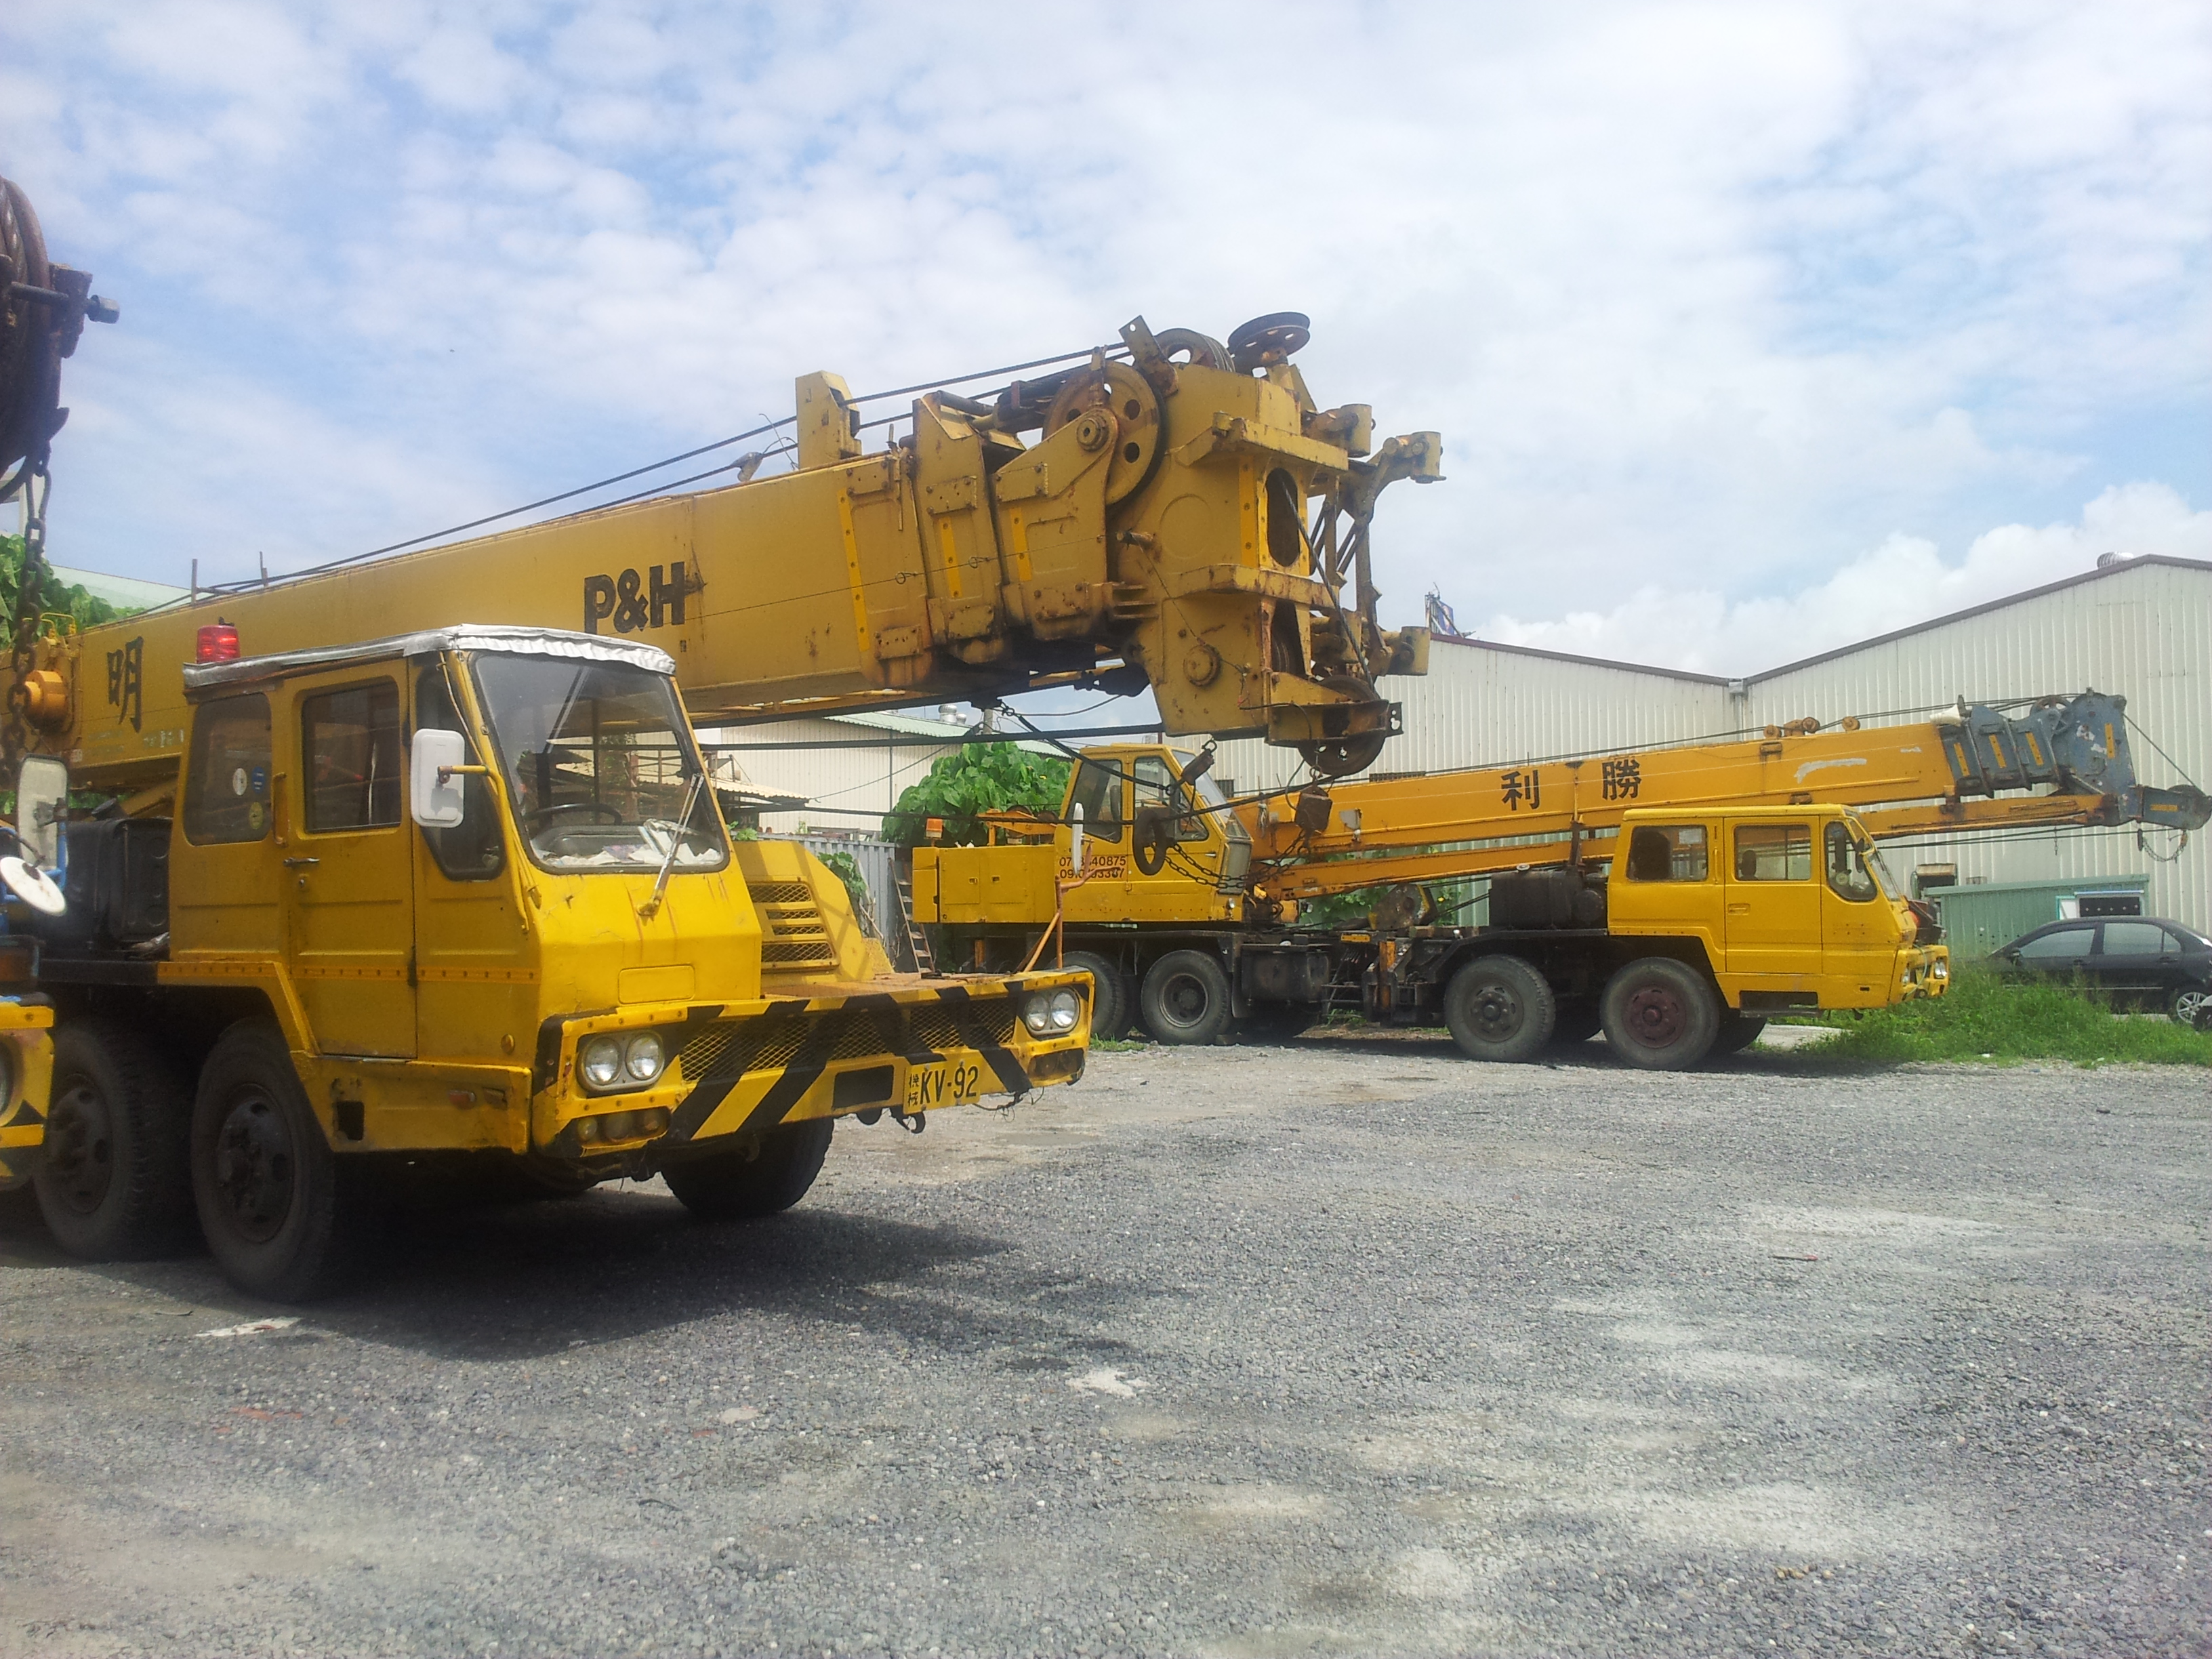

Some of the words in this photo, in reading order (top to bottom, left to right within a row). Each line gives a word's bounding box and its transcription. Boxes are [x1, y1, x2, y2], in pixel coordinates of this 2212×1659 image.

[584, 561, 685, 634] P&H
[106, 636, 144, 733] 明
[1500, 770, 1540, 811] 利
[1602, 758, 1641, 801] 勝
[920, 1066, 979, 1105] KV-92
